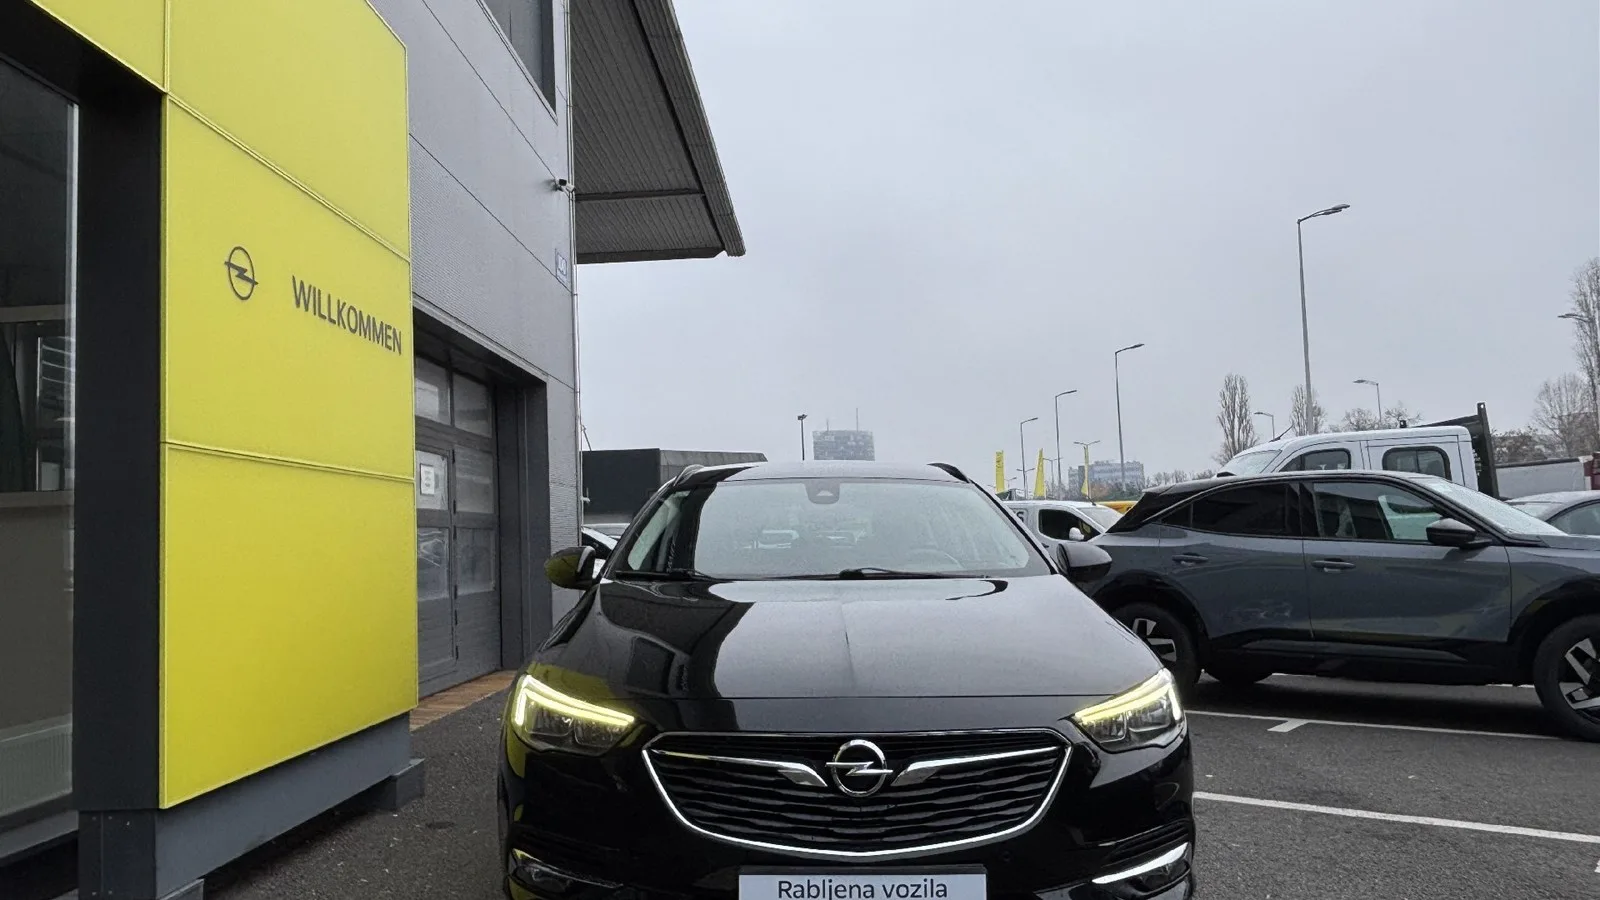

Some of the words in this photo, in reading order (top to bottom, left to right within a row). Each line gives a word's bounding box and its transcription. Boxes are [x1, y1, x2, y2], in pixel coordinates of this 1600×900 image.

[292, 275, 402, 356] WILLKOMMEN
[778, 878, 875, 900] Rabljena
[882, 878, 948, 899] vozila
